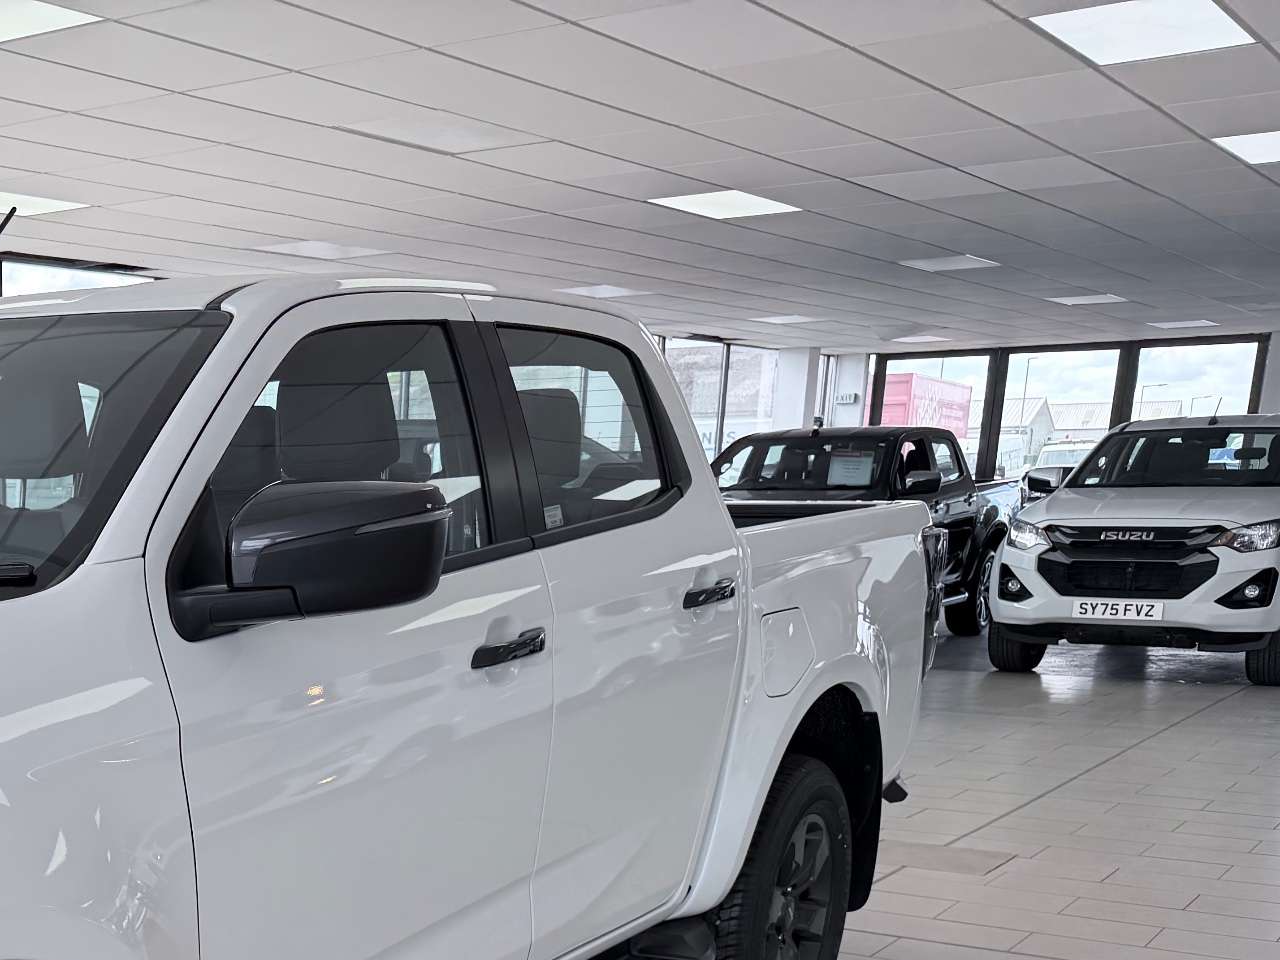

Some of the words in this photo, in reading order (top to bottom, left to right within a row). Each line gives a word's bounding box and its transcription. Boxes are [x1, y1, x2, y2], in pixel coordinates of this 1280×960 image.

[1100, 531, 1155, 540] ISUZU
[1079, 602, 1120, 616] SY75
[1123, 603, 1155, 617] FVZ
